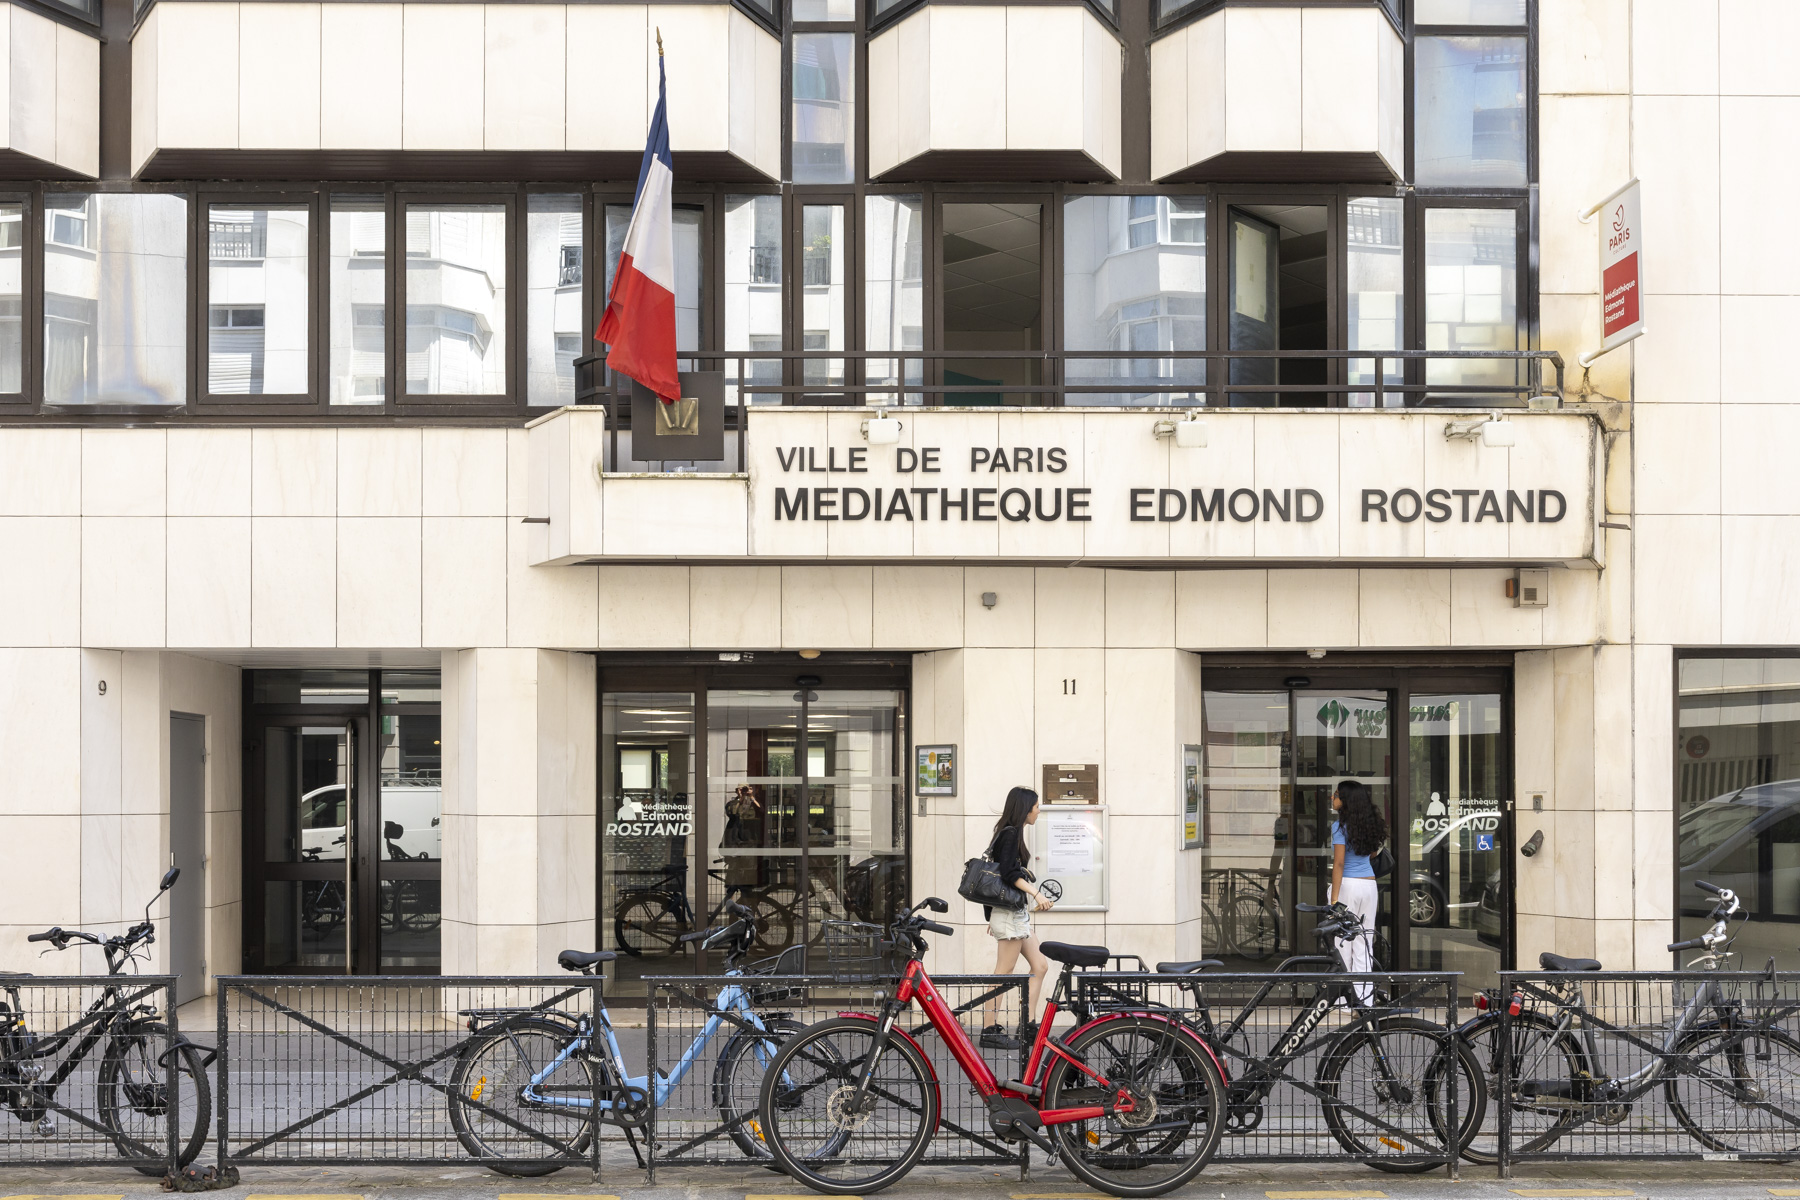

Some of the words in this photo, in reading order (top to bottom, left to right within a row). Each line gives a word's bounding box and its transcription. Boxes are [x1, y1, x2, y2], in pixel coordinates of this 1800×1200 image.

[1609, 228, 1630, 251] PARIS
[1613, 243, 1627, 255] CULTURE
[1605, 280, 1636, 302] Médiathèque
[1605, 296, 1625, 313] Edmond
[1605, 308, 1625, 324] Rostand
[776, 447, 868, 473] VILLE
[896, 447, 941, 473] DE
[970, 447, 1067, 473] PARIS
[775, 487, 1092, 523] MEDIATHEQUE
[1130, 488, 1324, 523] EDMOND
[1361, 488, 1567, 523] ROSTAND
[98, 680, 107, 695] 9
[1062, 678, 1077, 695] 11
[641, 803, 693, 811] Médiathèque
[1448, 806, 1498, 816] Edmond
[641, 811, 692, 820] Edmond
[605, 823, 693, 836] ROSTAND
[1412, 818, 1499, 831] ROSAND
[1281, 999, 1328, 1056] zoomo
